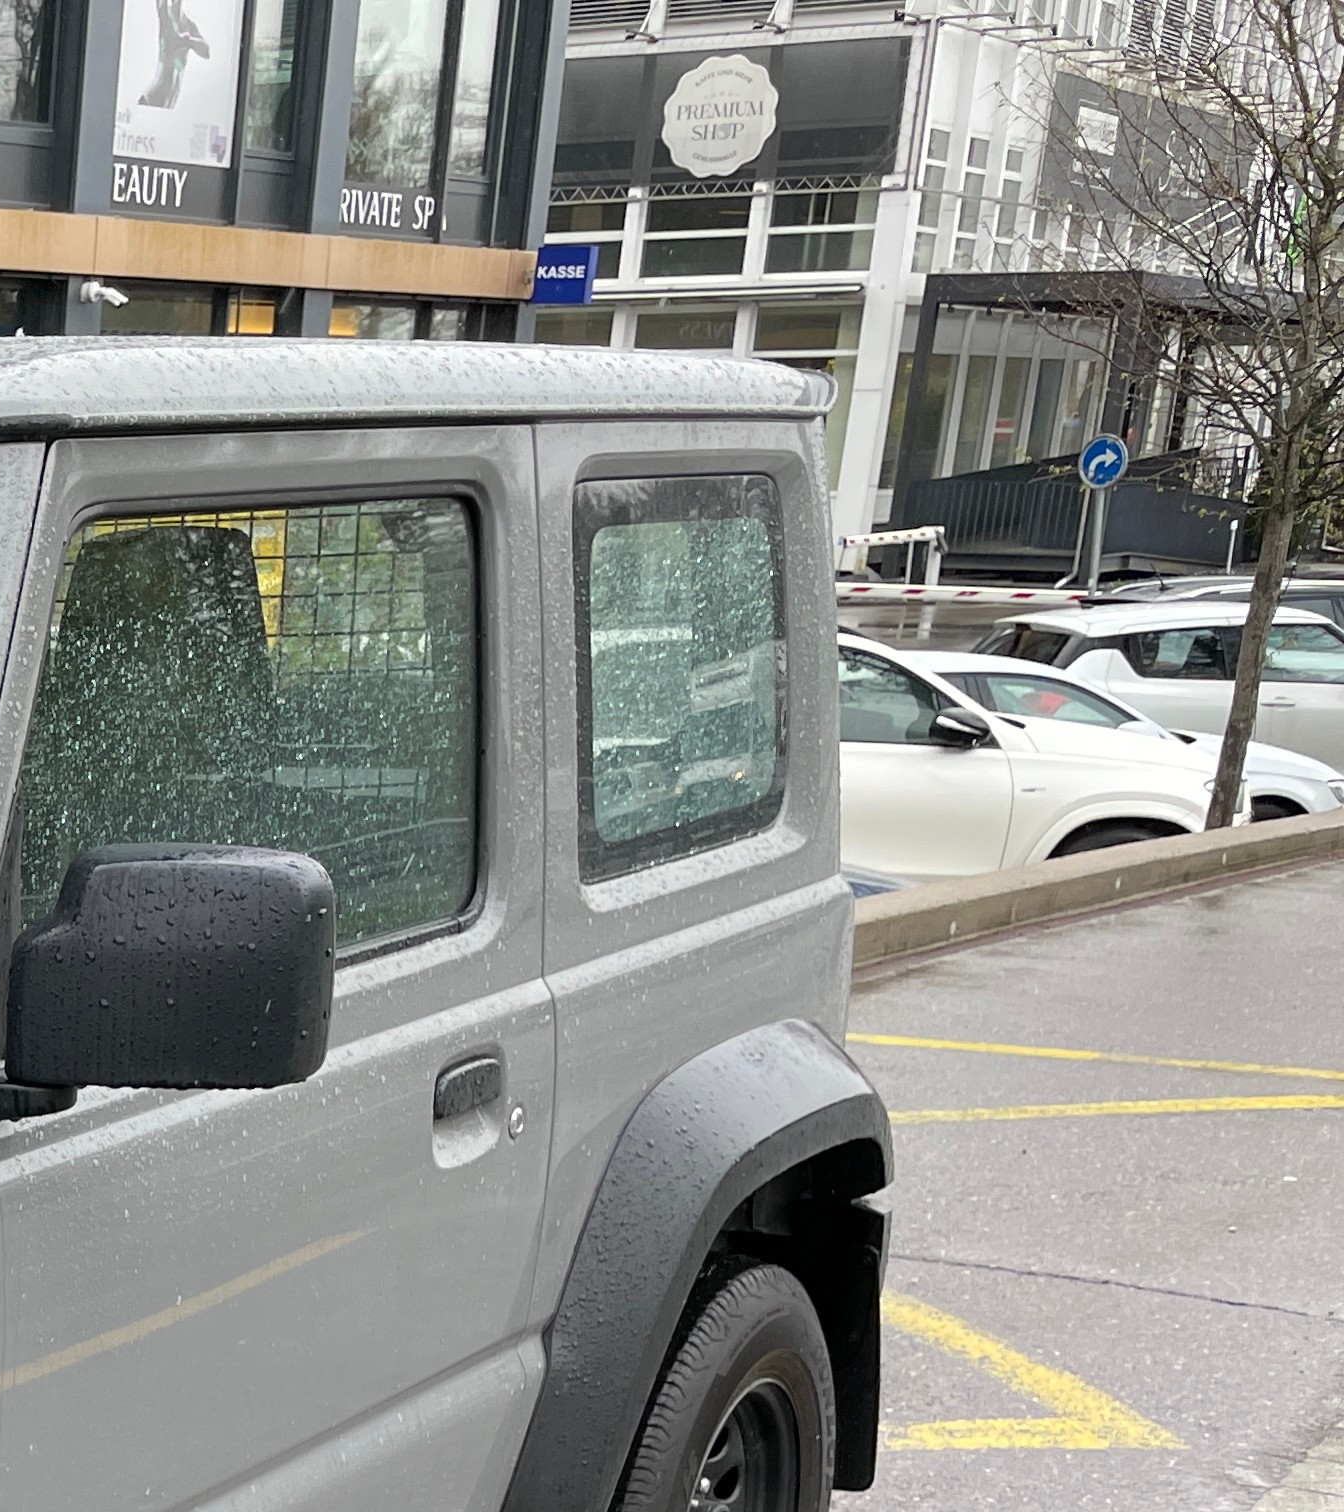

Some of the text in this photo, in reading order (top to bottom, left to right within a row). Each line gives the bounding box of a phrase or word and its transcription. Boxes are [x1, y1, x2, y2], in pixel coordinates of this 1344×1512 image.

[676, 101, 765, 121] PREMIUM
[691, 122, 745, 141] SHOP
[112, 163, 188, 208] EAUTY
[412, 195, 447, 231] SP
[536, 264, 586, 279] KASSE
